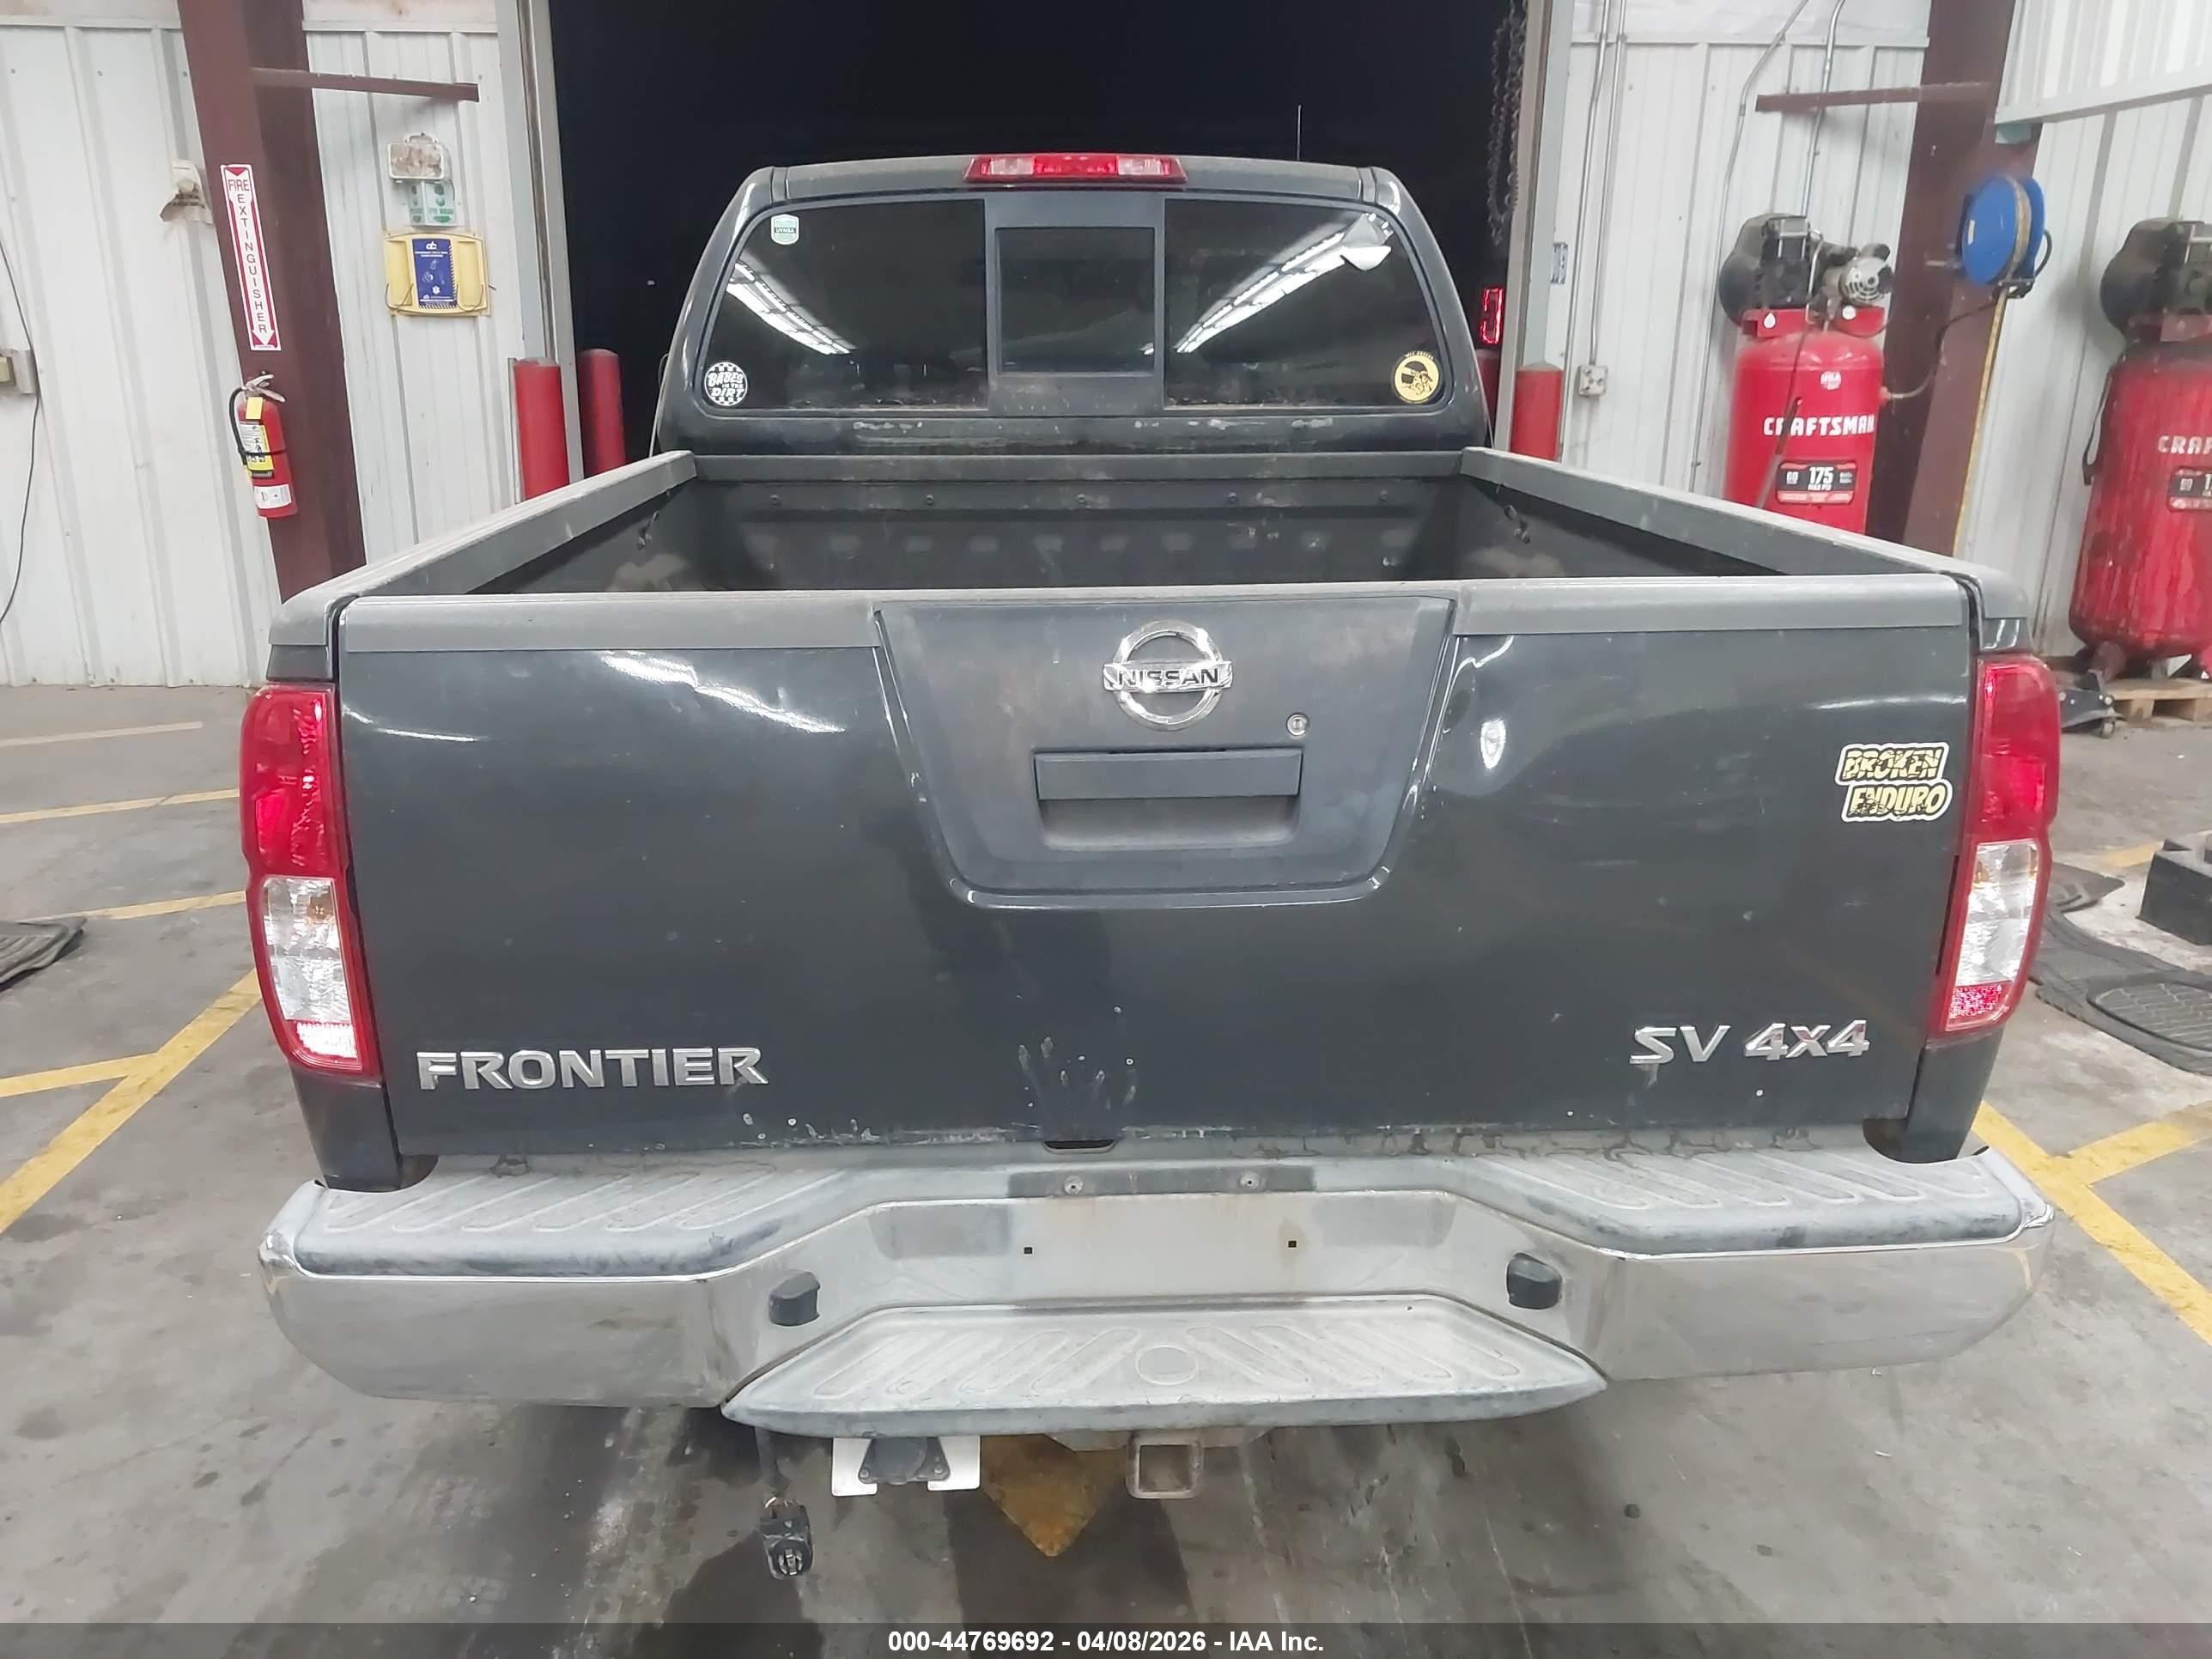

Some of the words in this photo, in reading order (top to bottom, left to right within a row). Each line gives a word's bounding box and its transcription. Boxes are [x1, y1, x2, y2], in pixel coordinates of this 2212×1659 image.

[228, 179, 250, 191] FIRE
[237, 193, 268, 333] EXTINGUISHER
[708, 371, 744, 387] BABES
[711, 387, 744, 398] DIRT
[1809, 466, 1834, 483] 175
[1118, 667, 1218, 686] NISSAN
[1841, 748, 1943, 780] BROKEN
[1847, 784, 1947, 816] ENDURO
[1630, 1024, 1731, 1064] SV
[416, 1047, 769, 1091] FRONTIER
